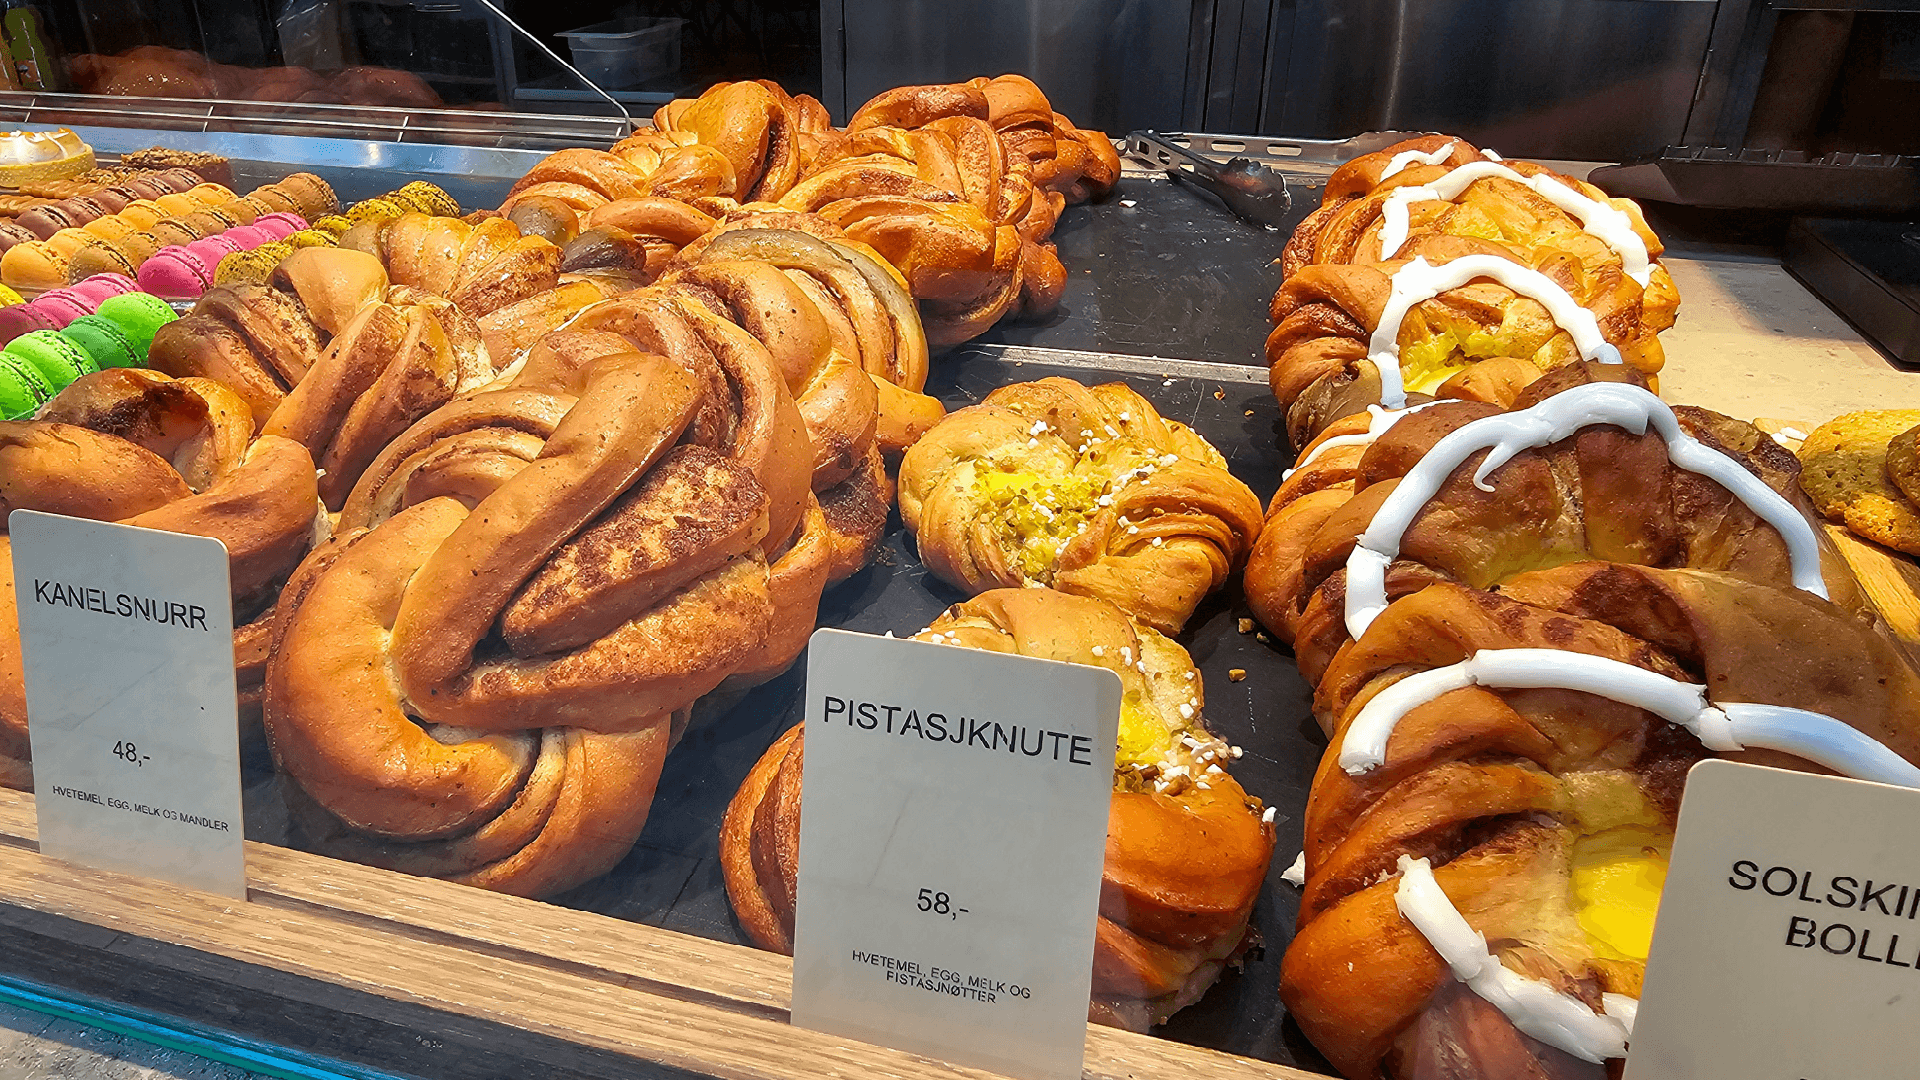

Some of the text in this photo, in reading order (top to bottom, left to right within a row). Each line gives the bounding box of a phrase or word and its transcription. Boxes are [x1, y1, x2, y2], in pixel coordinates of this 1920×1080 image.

[34, 578, 209, 632] KANELSNURR
[111, 739, 151, 767] 48,-
[823, 695, 1093, 766] PISTASJKNUTE
[52, 785, 106, 807] HVETEMEL,
[107, 797, 132, 812] EGG,
[134, 803, 161, 817] MELK
[179, 812, 229, 832] MANDLER
[916, 888, 969, 919] 58,-
[1785, 915, 1920, 970] BOLL
[852, 949, 1031, 1000] HVETEMEL, EGG, MELK OG
